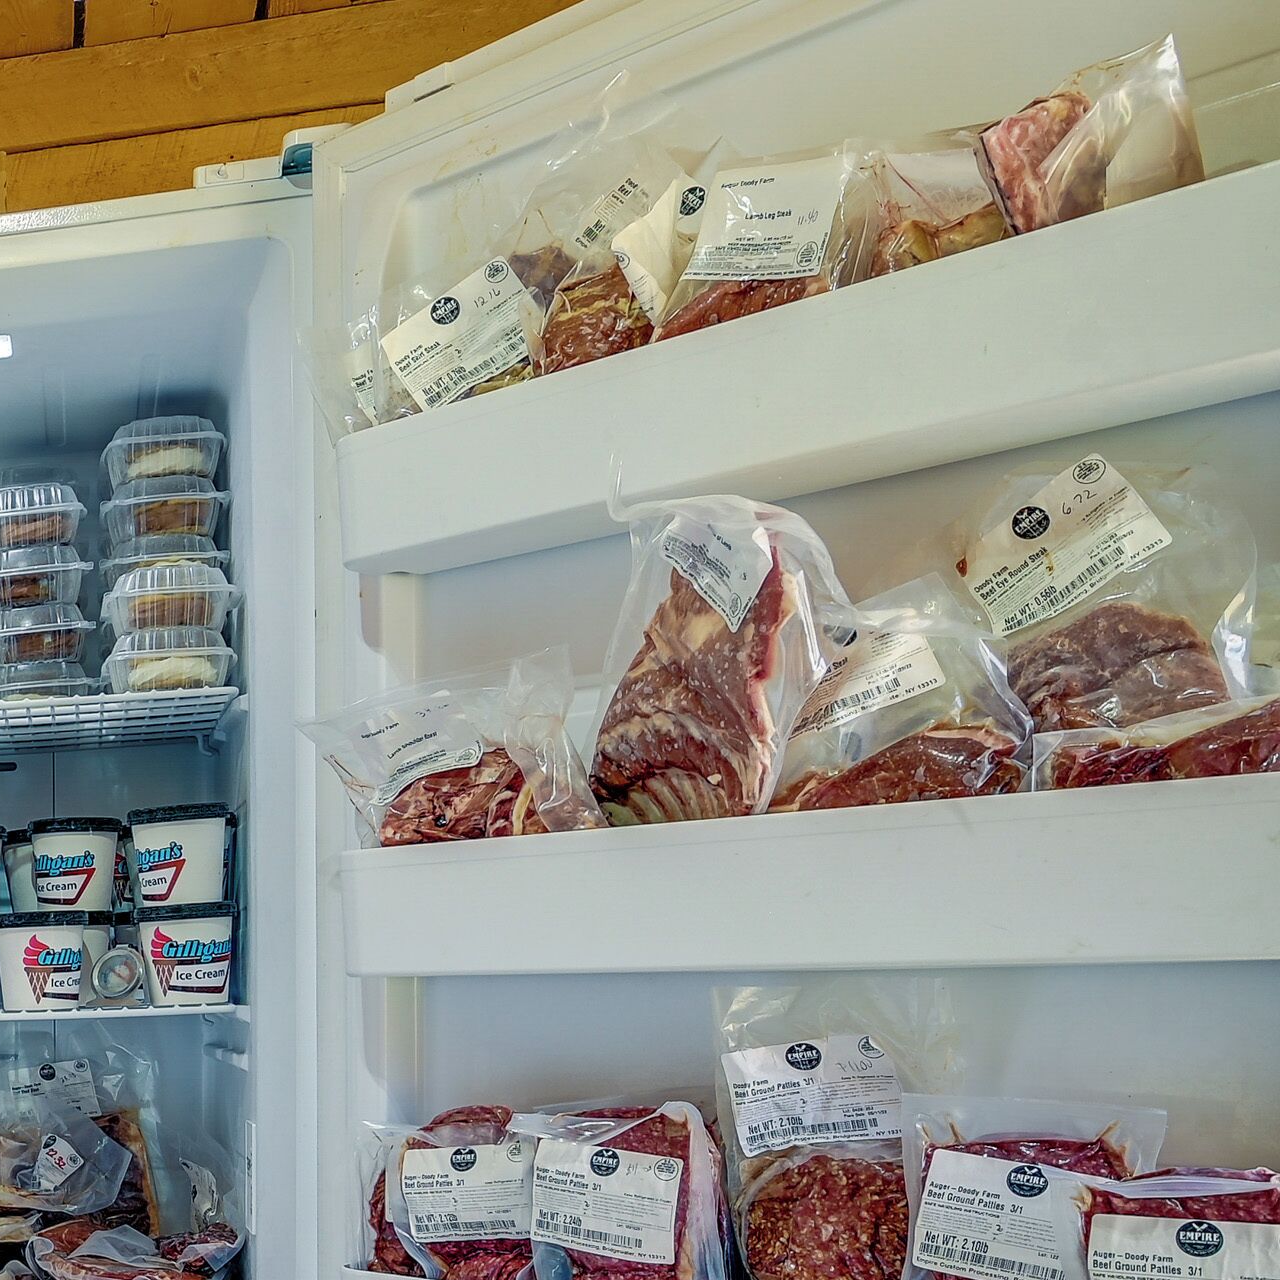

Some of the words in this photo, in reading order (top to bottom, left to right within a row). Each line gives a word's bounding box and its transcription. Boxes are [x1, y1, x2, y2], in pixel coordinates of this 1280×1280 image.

[1008, 559, 1030, 579] Round
[1028, 547, 1048, 564] Steak
[45, 881, 77, 893] Cream
[141, 876, 167, 888] Cream
[175, 969, 192, 981] Ice
[194, 967, 226, 980] Cream
[752, 1085, 775, 1097] Ground
[777, 1081, 800, 1092] Patties
[779, 1116, 803, 1128] 2.10lb
[1010, 1172, 1046, 1186] EMPIRE
[927, 1189, 945, 1200] Beef
[947, 1193, 975, 1206] Ground
[977, 1198, 1005, 1211] Patties
[1009, 1203, 1024, 1214] 3/1
[982, 1190, 1001, 1199] Farm
[924, 1231, 941, 1244] Net
[942, 1234, 960, 1249] WT:
[961, 1238, 989, 1254] 2.10lb
[1179, 1231, 1220, 1243] EMPIRE
[1093, 1250, 1116, 1260] Auger
[1125, 1252, 1149, 1263] Doody
[1152, 1254, 1174, 1263] Farm
[916, 1256, 938, 1267] Empire
[940, 1261, 967, 1273] Custom
[1093, 1259, 1112, 1269] Beef
[1115, 1261, 1147, 1273] Ground
[1150, 1264, 1182, 1275] Patties
[1188, 1266, 1203, 1277] 3/1
